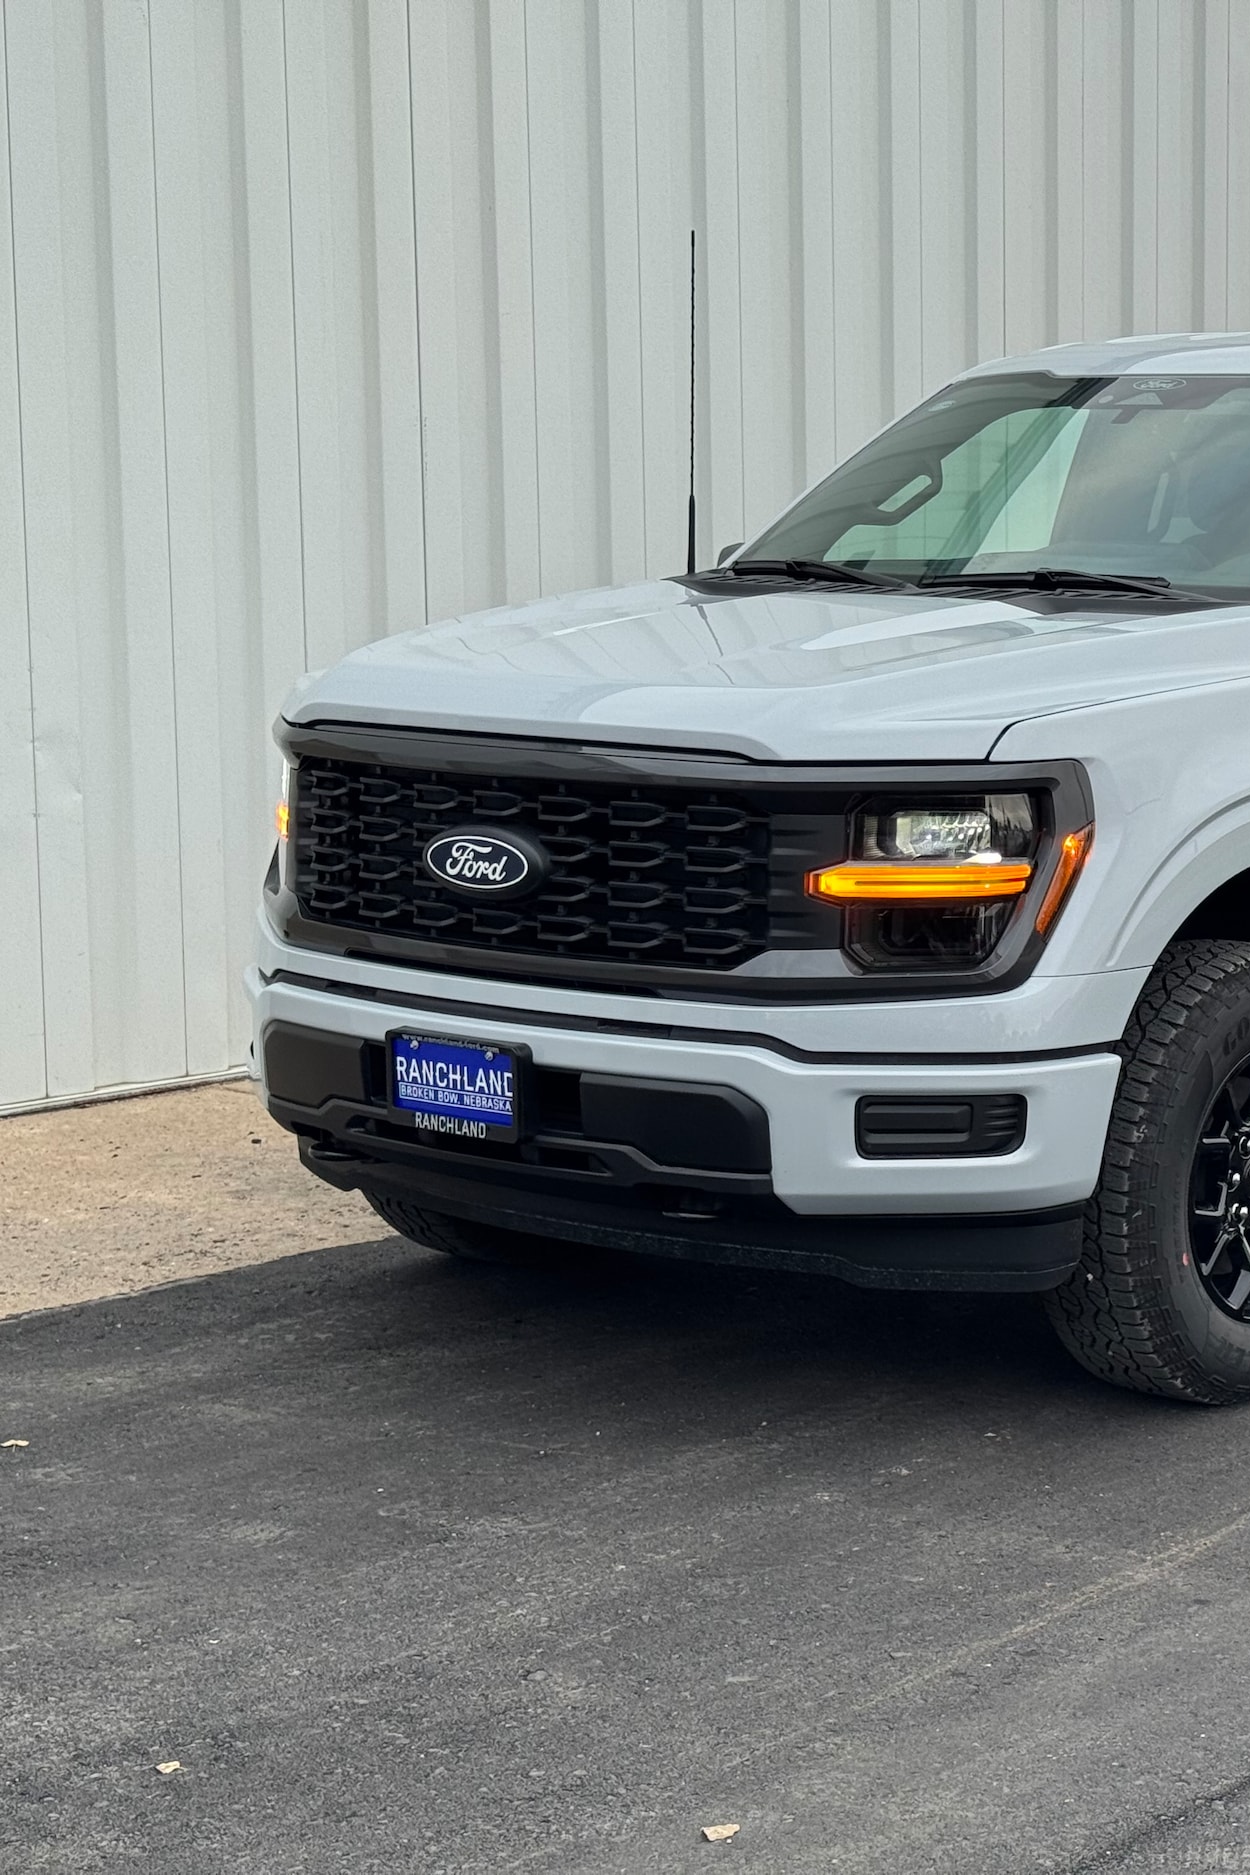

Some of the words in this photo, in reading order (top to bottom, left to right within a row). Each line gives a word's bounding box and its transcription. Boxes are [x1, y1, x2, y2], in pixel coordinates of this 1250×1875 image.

[445, 842, 508, 881] Ford
[396, 1056, 513, 1097] RANCHLAND
[401, 1085, 435, 1100] BROKEN
[463, 1095, 512, 1111] NEBRASKA
[415, 1111, 487, 1139] RANCHLAND
